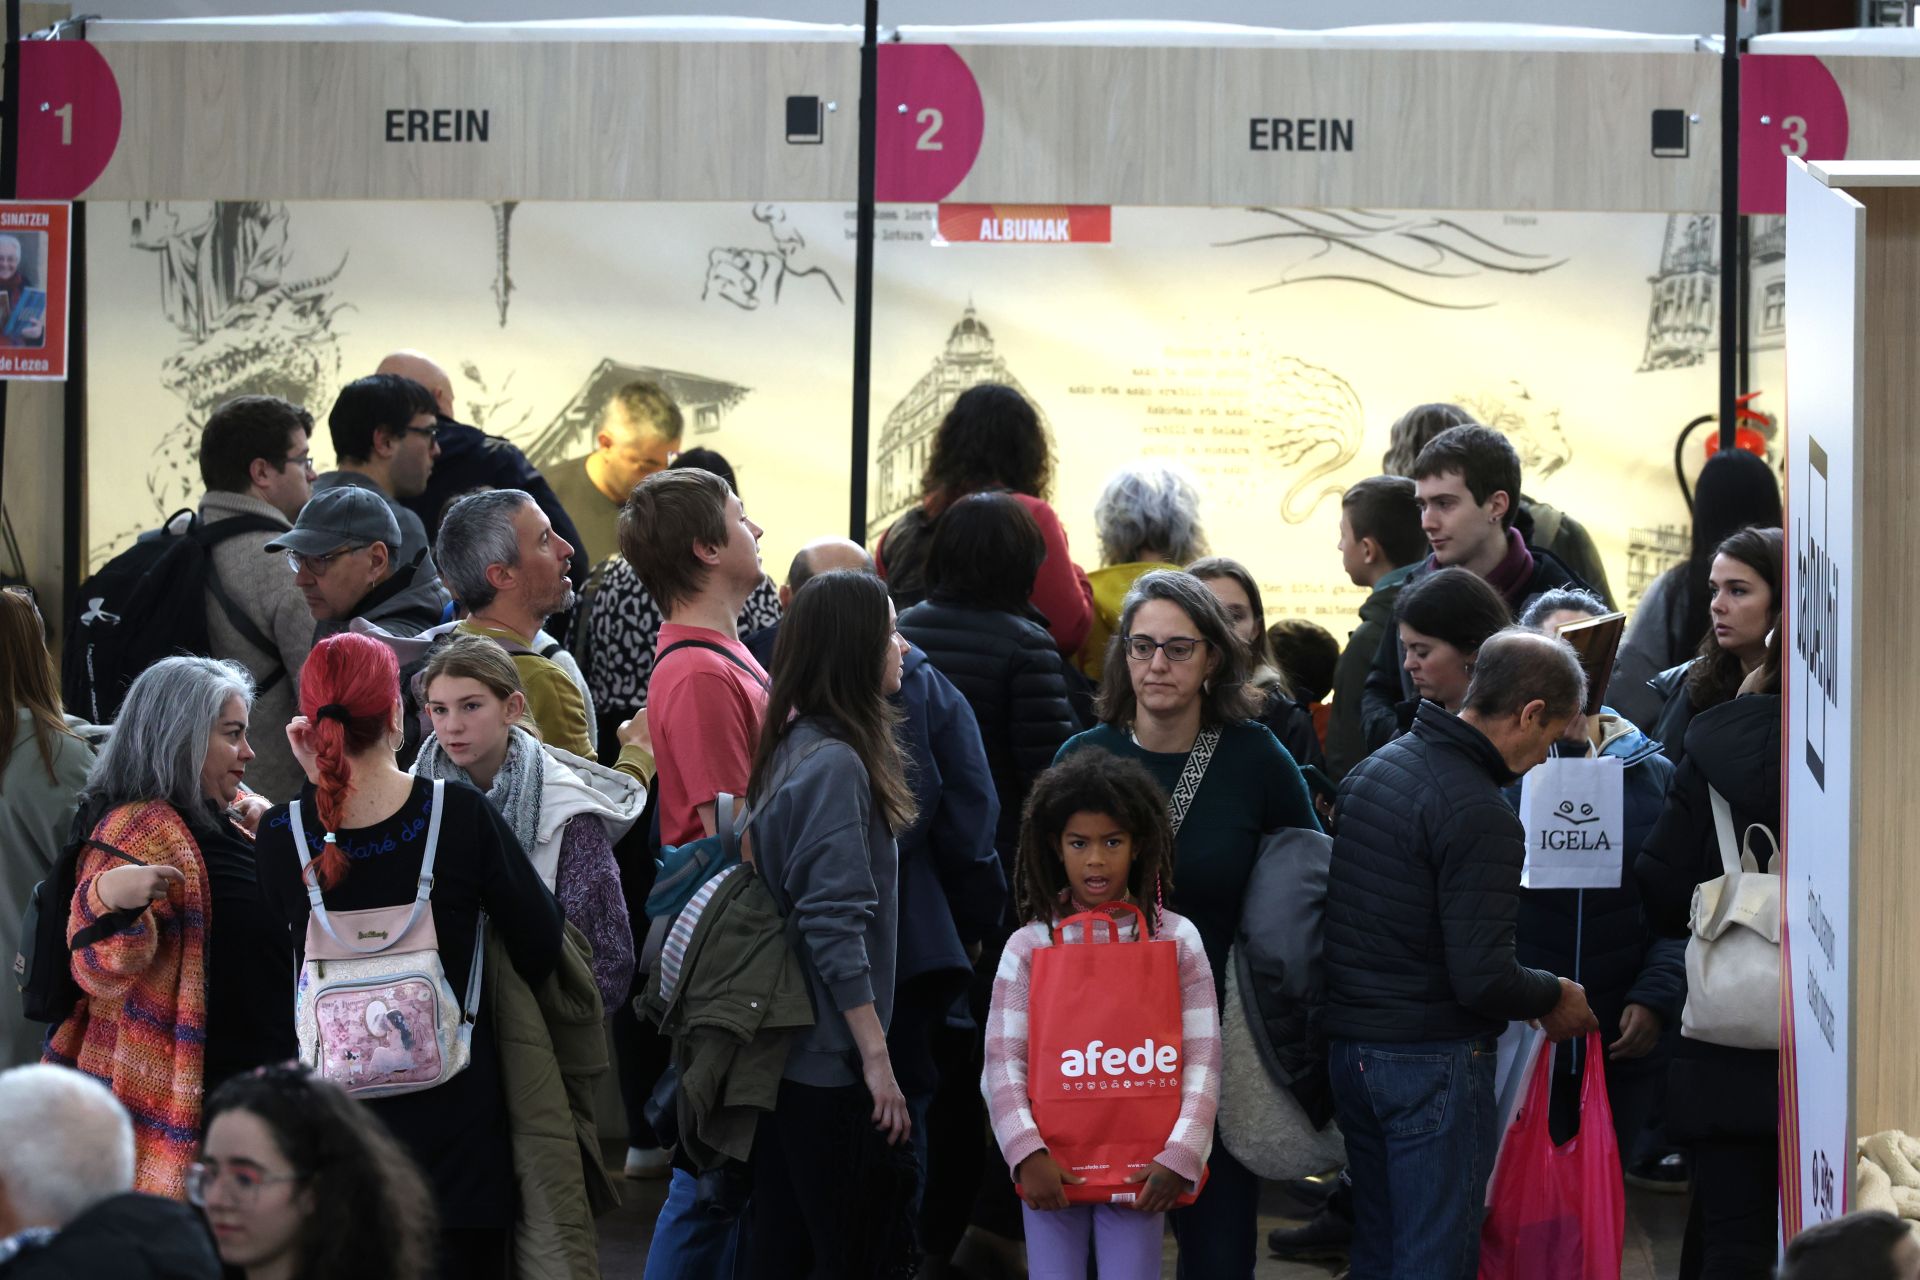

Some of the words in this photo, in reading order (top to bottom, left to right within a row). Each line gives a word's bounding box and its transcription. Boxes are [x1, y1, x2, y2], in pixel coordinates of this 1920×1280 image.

[54, 103, 72, 145] 1
[385, 109, 489, 142] EREIN
[916, 108, 943, 150] 2
[1249, 118, 1353, 151] EREIN
[1780, 116, 1808, 157] 3
[0, 213, 49, 227] SINATZEN
[979, 218, 1069, 241] ALBUMAK
[15, 358, 49, 371] Lezea
[1541, 830, 1611, 850] IGELA
[1061, 1039, 1178, 1077] afede
